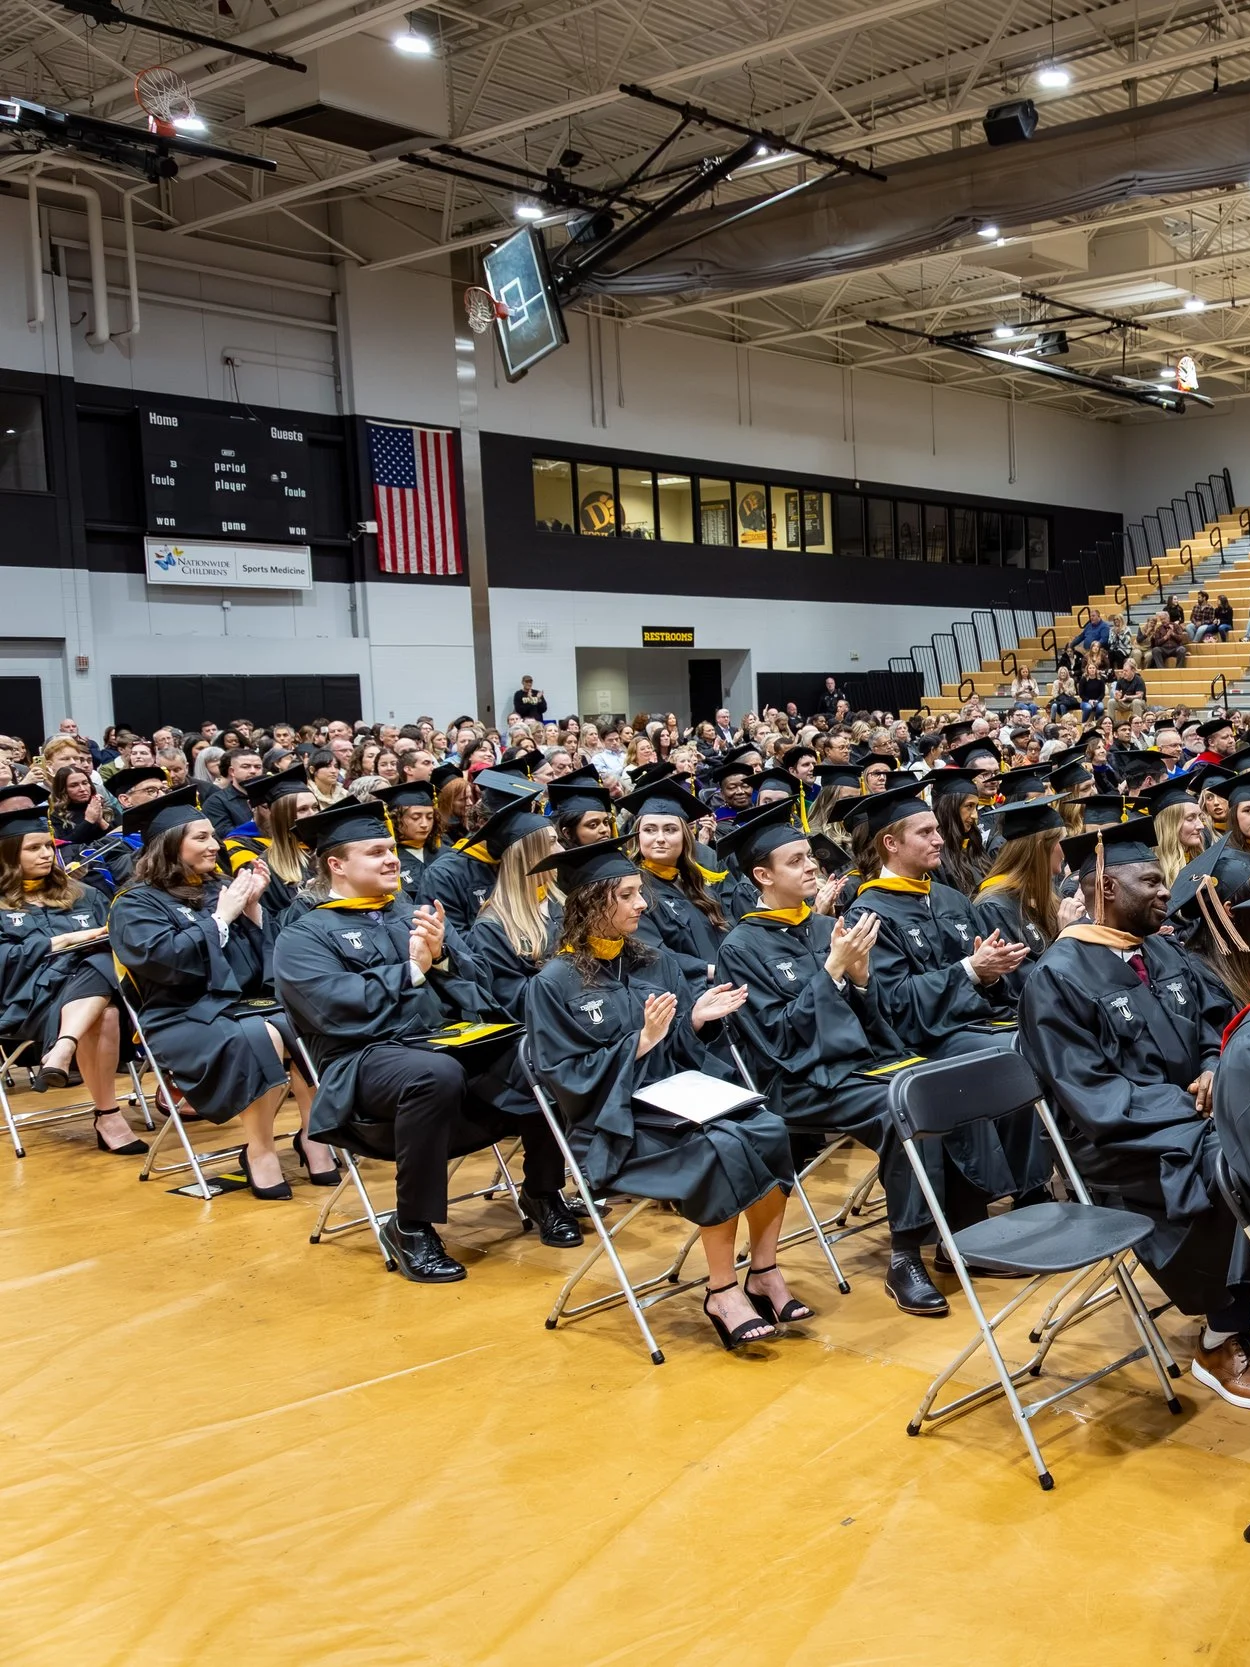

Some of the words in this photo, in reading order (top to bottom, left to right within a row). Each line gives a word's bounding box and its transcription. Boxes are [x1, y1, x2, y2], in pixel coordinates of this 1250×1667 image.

[150, 412, 179, 427] Home
[270, 427, 304, 442] Guests
[214, 462, 246, 474] period
[151, 474, 175, 486] fouls
[215, 479, 247, 492] player
[285, 486, 306, 498] fouls
[156, 516, 176, 527] won
[221, 521, 246, 532] game
[289, 526, 306, 535] won
[177, 557, 231, 568] NATIONWIDE
[242, 564, 269, 574] Sports
[270, 566, 305, 576] Medicine
[644, 632, 693, 642] RESTROOMS
